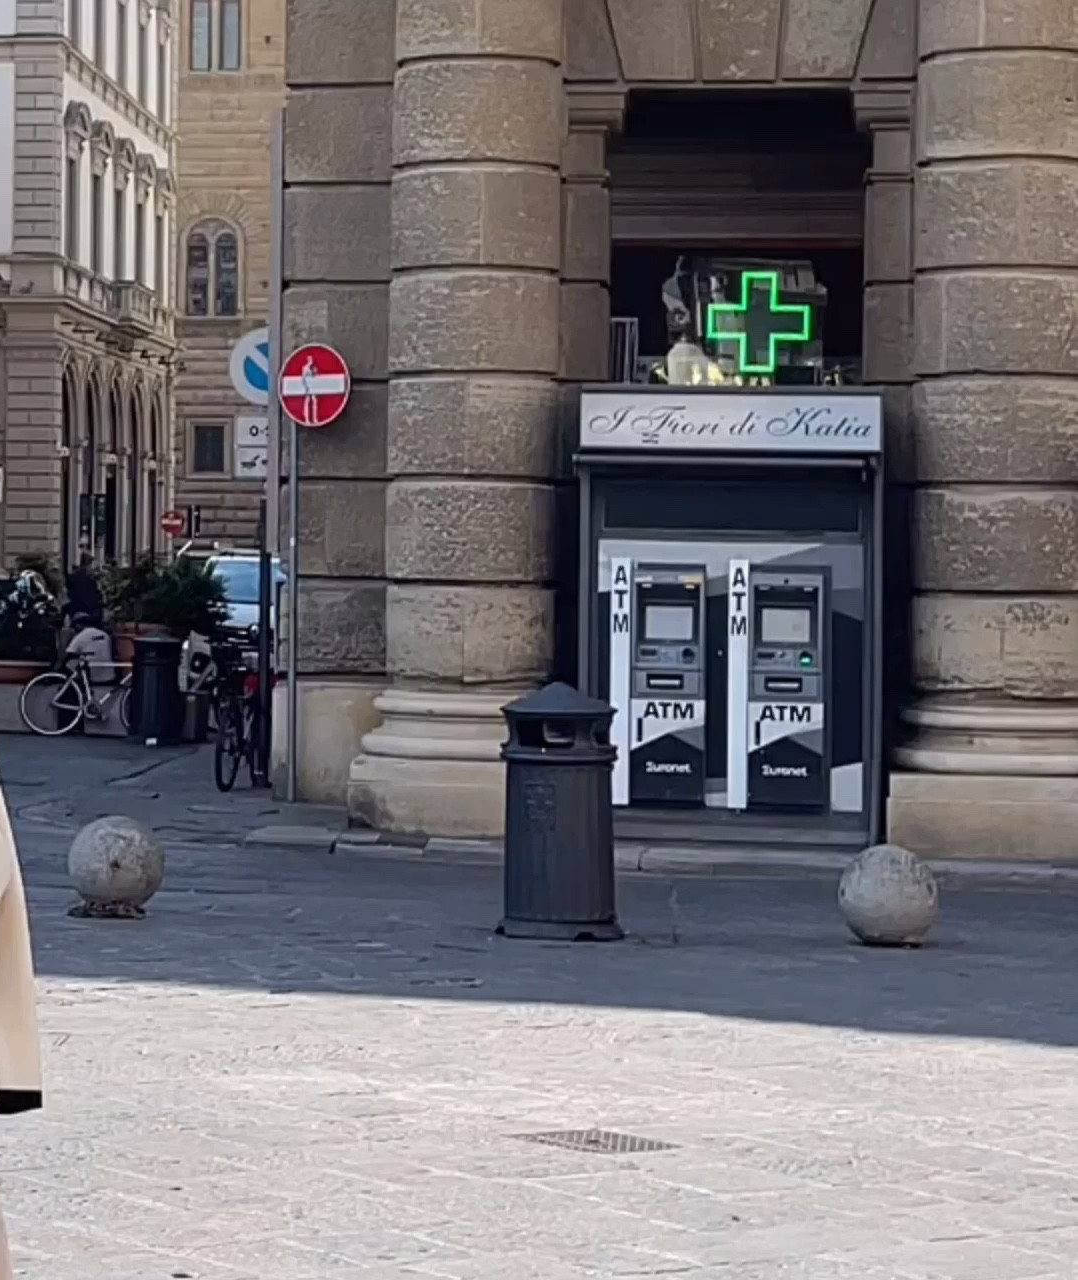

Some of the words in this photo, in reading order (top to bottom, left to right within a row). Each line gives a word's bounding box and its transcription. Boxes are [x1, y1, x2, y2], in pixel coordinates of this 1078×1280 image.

[588, 405, 633, 435] I
[630, 405, 725, 436] Fiori
[728, 411, 761, 436] di
[765, 407, 873, 438] Katia
[613, 565, 629, 634] ATM
[731, 567, 747, 636] ATM
[643, 701, 695, 719] ATM
[759, 705, 812, 723] ATM
